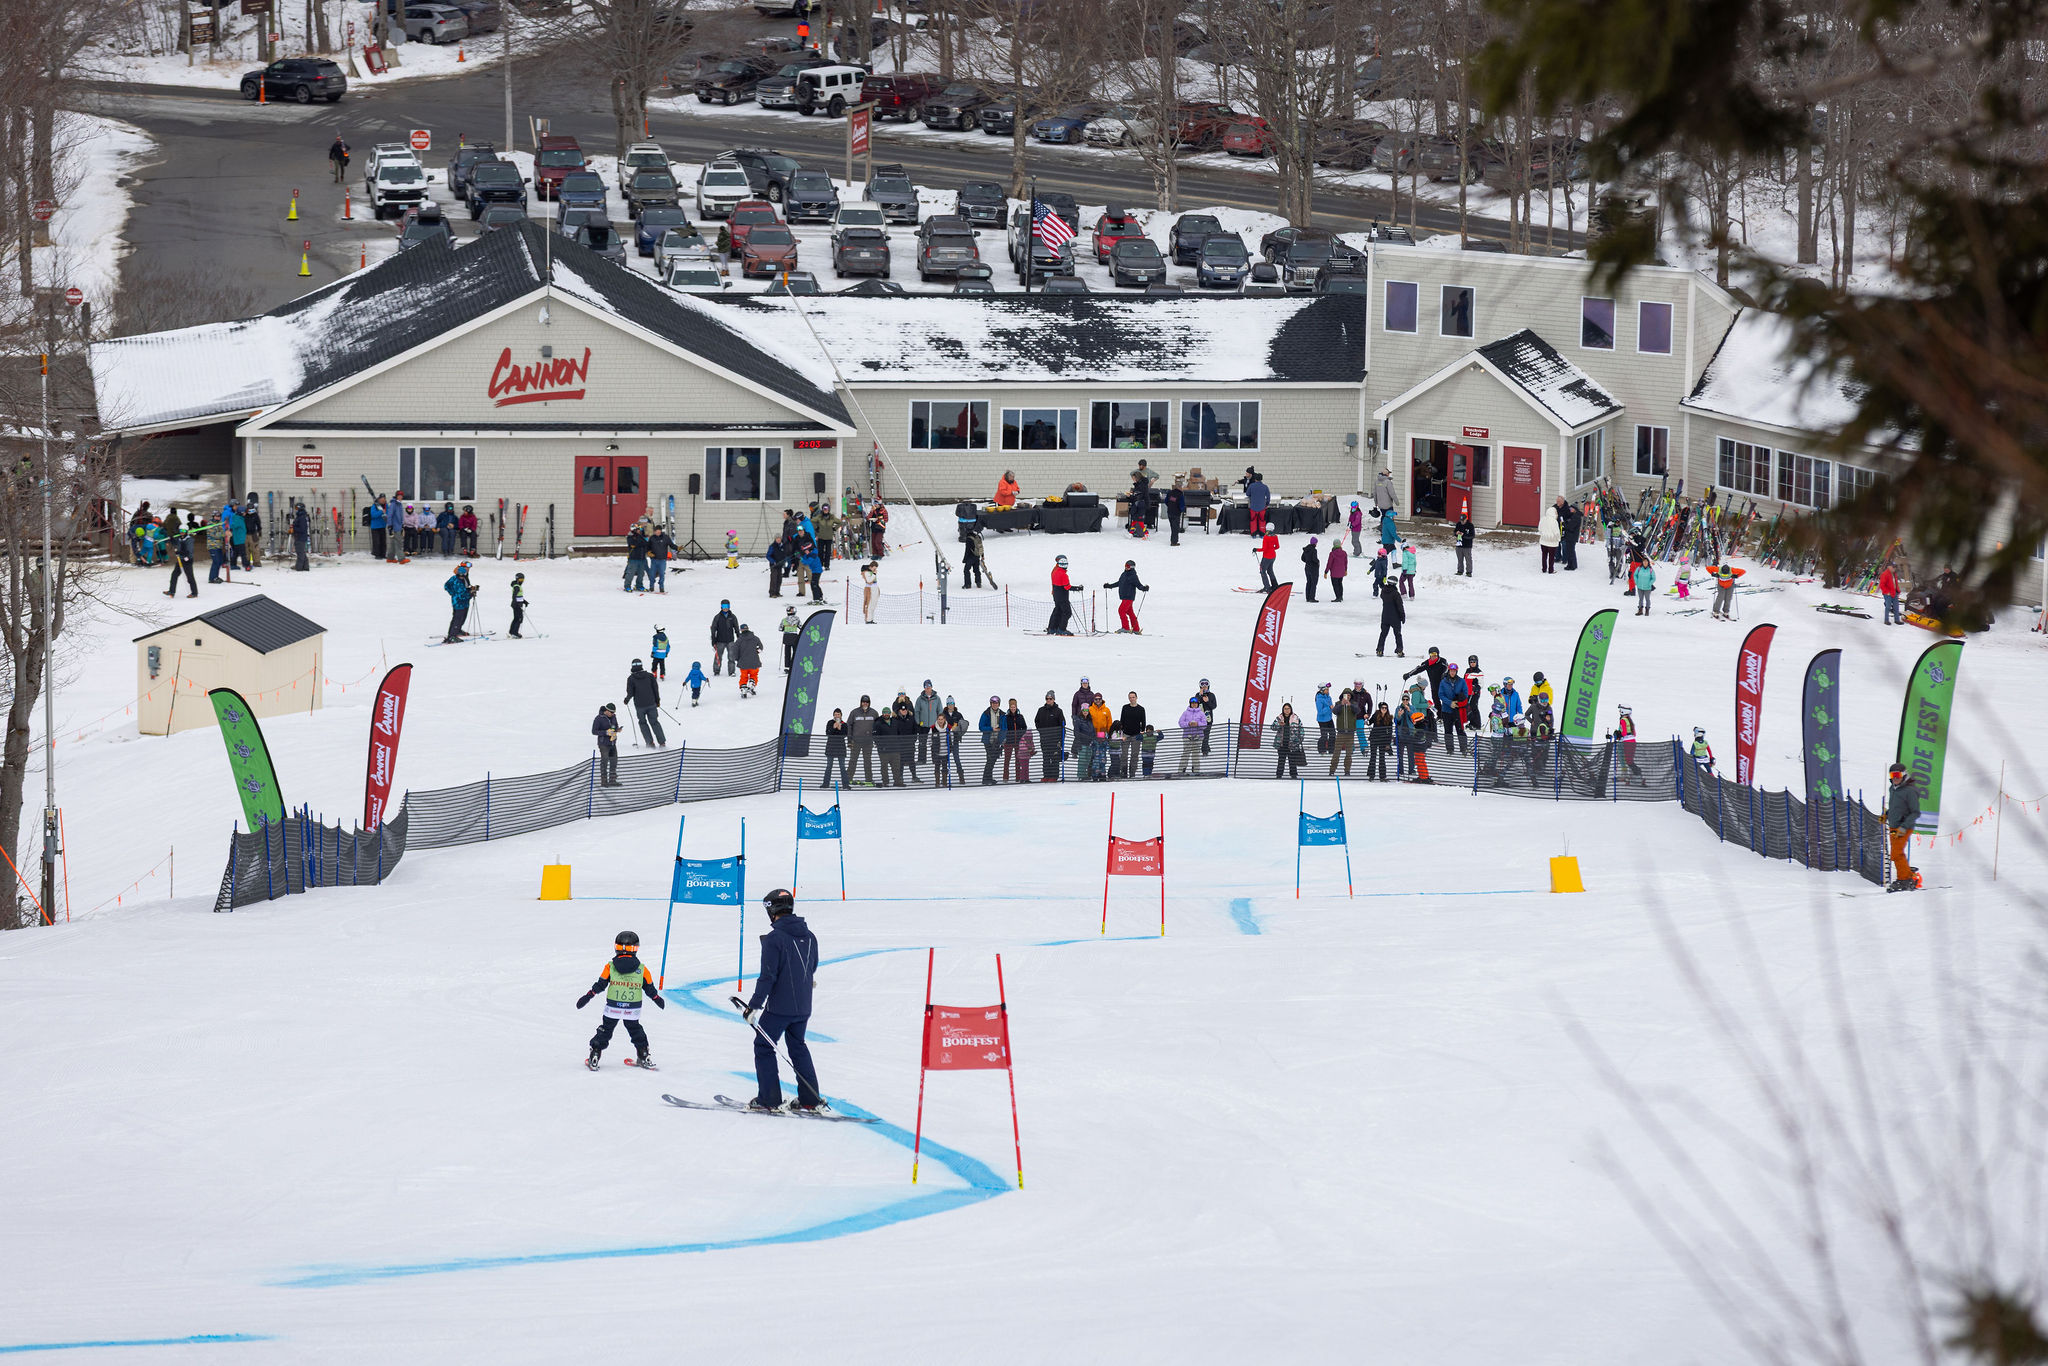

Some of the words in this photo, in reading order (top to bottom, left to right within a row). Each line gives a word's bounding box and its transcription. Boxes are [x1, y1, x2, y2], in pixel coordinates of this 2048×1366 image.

[488, 346, 591, 399] CANNON
[799, 440, 821, 448] 2:03
[1258, 606, 1277, 647] CANNON
[1250, 651, 1268, 691] CANNON
[1580, 650, 1600, 687] FEST
[1739, 649, 1759, 695] CANNON
[375, 690, 395, 736] CANNON
[1574, 687, 1593, 729] BODE
[1739, 700, 1753, 746] CANNON
[1916, 697, 1941, 744] FEST
[370, 741, 386, 787] CANNON
[686, 880, 732, 888] BODEFEST
[615, 990, 635, 1001] 163
[942, 1036, 1000, 1048] BODEFEST
